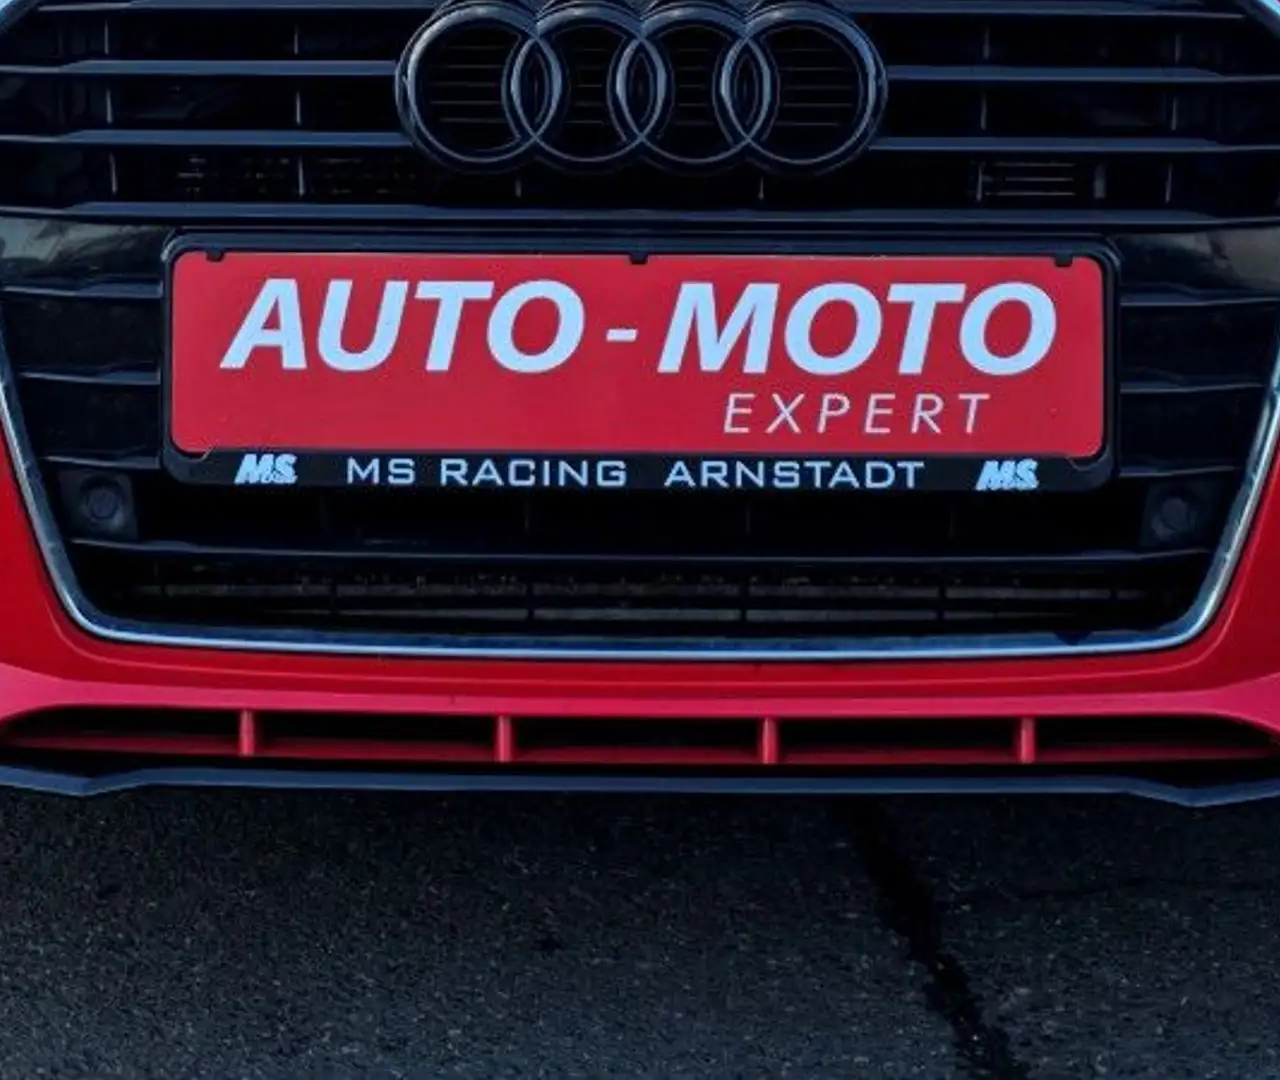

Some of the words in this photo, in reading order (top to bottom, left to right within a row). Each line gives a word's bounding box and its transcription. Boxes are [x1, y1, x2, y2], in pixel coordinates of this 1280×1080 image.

[723, 393, 991, 435] EXPERT
[234, 453, 299, 485] MS
[346, 458, 416, 486] MS
[439, 458, 628, 488] RACING
[664, 460, 924, 490] ARNSTADT
[975, 458, 1040, 491] MS
